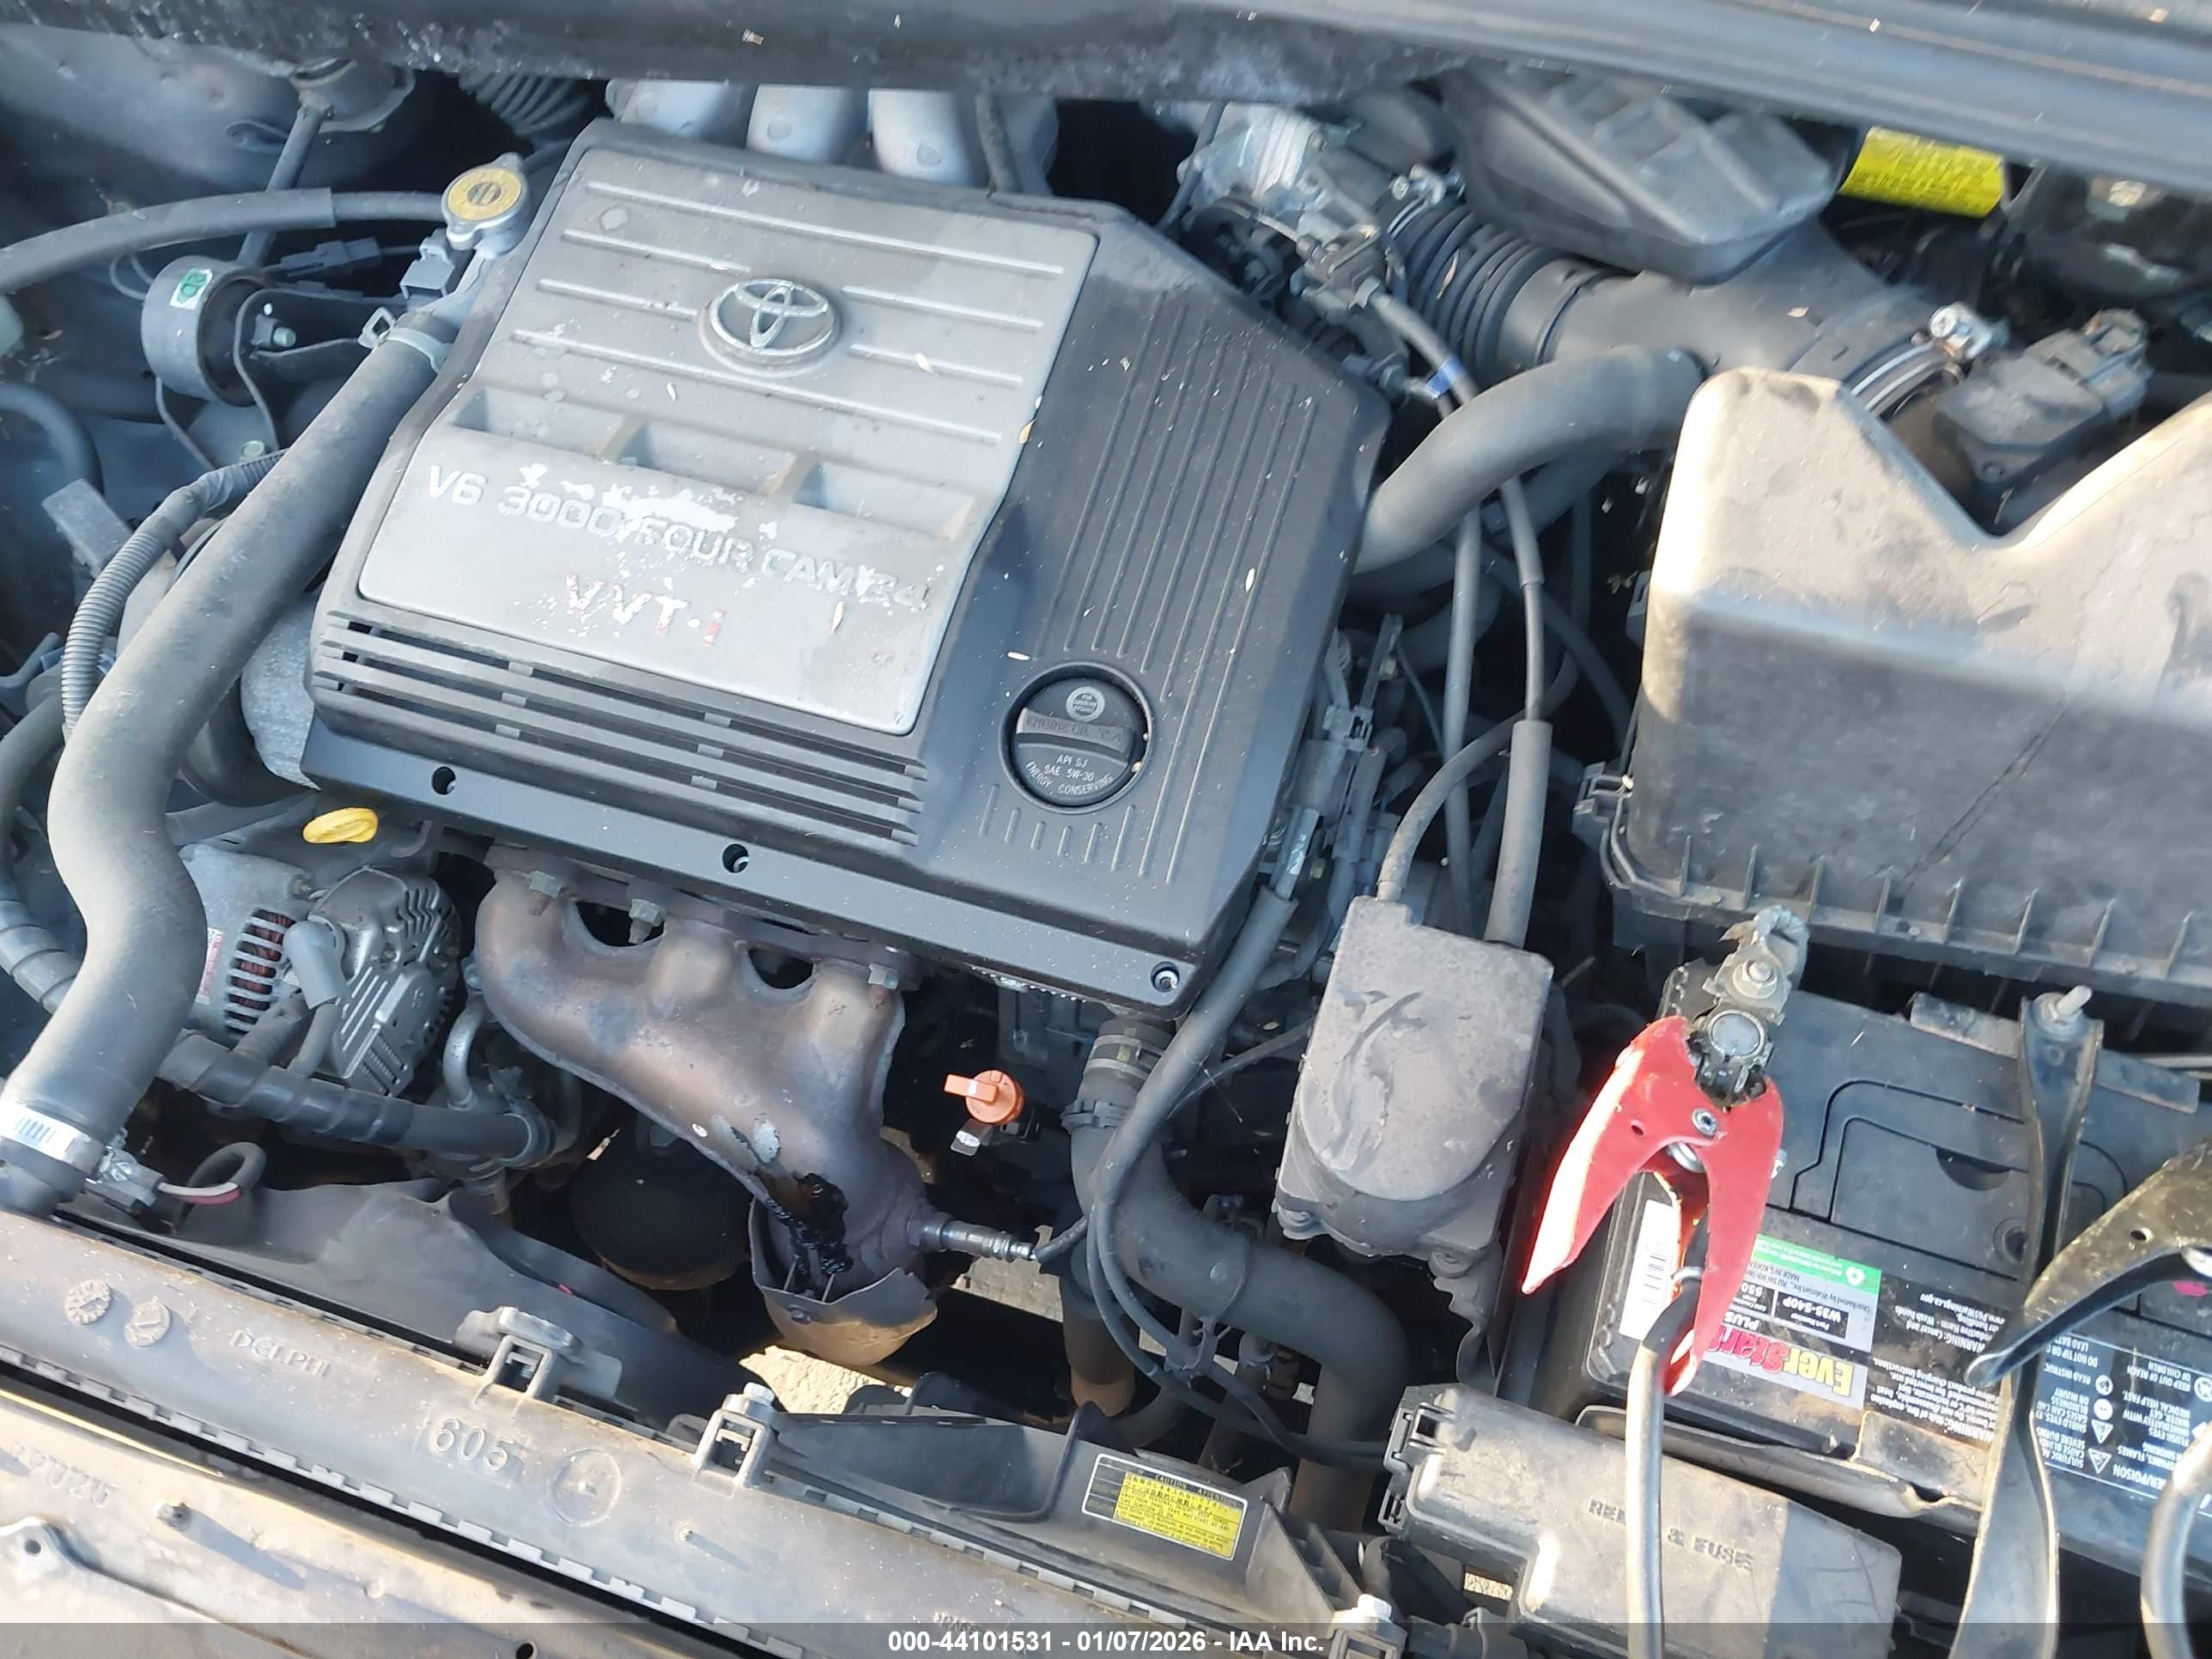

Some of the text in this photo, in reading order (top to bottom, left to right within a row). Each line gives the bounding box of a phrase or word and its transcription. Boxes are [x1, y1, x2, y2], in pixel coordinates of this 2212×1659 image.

[428, 464, 486, 506] V6
[640, 516, 753, 573] FOUR
[761, 547, 856, 596] CAM
[1056, 754, 1073, 766] API
[1043, 764, 1061, 776] SAE
[1025, 761, 1114, 796] ENERGY CONSERVING
[1767, 1275, 1778, 1284] SW
[1783, 1270, 1799, 1281] MADE
[1801, 1285, 1828, 1300] Walmart
[1828, 1293, 1836, 1303] by
[1835, 1296, 1869, 1314] Distributed
[1893, 1304, 1916, 1319] hands
[1723, 1309, 1759, 1331] PLUS
[1790, 1311, 1829, 1331] Part Number
[1905, 1318, 1920, 1332] and
[1914, 1310, 1935, 1326] Wash
[1920, 1323, 1943, 1340] Cancer
[1939, 1318, 1960, 1334] Harm
[2051, 1344, 2062, 1357] OR
[2071, 1337, 2088, 1352] LEAD
[228, 1328, 331, 1378] DELPHI
[2061, 1346, 2073, 1360] TIP
[2073, 1350, 2087, 1364] NOT
[1871, 1356, 1916, 1377] instructions.
[2087, 1354, 2098, 1368] DO
[1915, 1368, 1947, 1388] charging
[2072, 1370, 2091, 1385] READ
[2126, 1364, 2191, 1392] KEEP OUT OF REACH
[2148, 1360, 2191, 1381] OF CHILDREN
[1875, 1384, 1893, 1399] heat
[1896, 1382, 1911, 1395] Not
[1904, 1375, 1935, 1393] inverted
[1934, 1385, 1946, 1396] for
[1947, 1379, 1976, 1396] product
[1869, 1392, 1905, 1412] explosion
[1949, 1399, 1958, 1408] or
[2054, 1386, 2089, 1406] OR INJURY
[2141, 1395, 2159, 1409] HELP
[1940, 1406, 1954, 1417] not
[2037, 1401, 2050, 1412] CAU
[2050, 1395, 2088, 1414] BLINDNESS
[2050, 1404, 2065, 1416] CAN
[2159, 1401, 2191, 1419] MEDICAL
[1919, 1408, 1928, 1420] of
[1928, 1411, 1944, 1425] Risk
[1953, 1409, 1965, 1421] Do
[2065, 1409, 2087, 1423] GASES
[2149, 1407, 2163, 1420] GET
[2062, 1418, 2087, 1433] SHIELD
[2123, 1408, 2189, 1437] IMMEDIATELY WITH
[2035, 1425, 2085, 1449] SEVERE BURNS
[2147, 1426, 2166, 1440] EYES
[430, 1416, 515, 1473] 605
[2062, 1443, 2084, 1459] CAUSE
[2142, 1441, 2175, 1461] SMOKING
[2051, 1449, 2083, 1468] SULFURIC
[2117, 1443, 2145, 1462] FLAMES
[1154, 1474, 1188, 1489] CAUTION
[1691, 1535, 1754, 1574] FUSE
